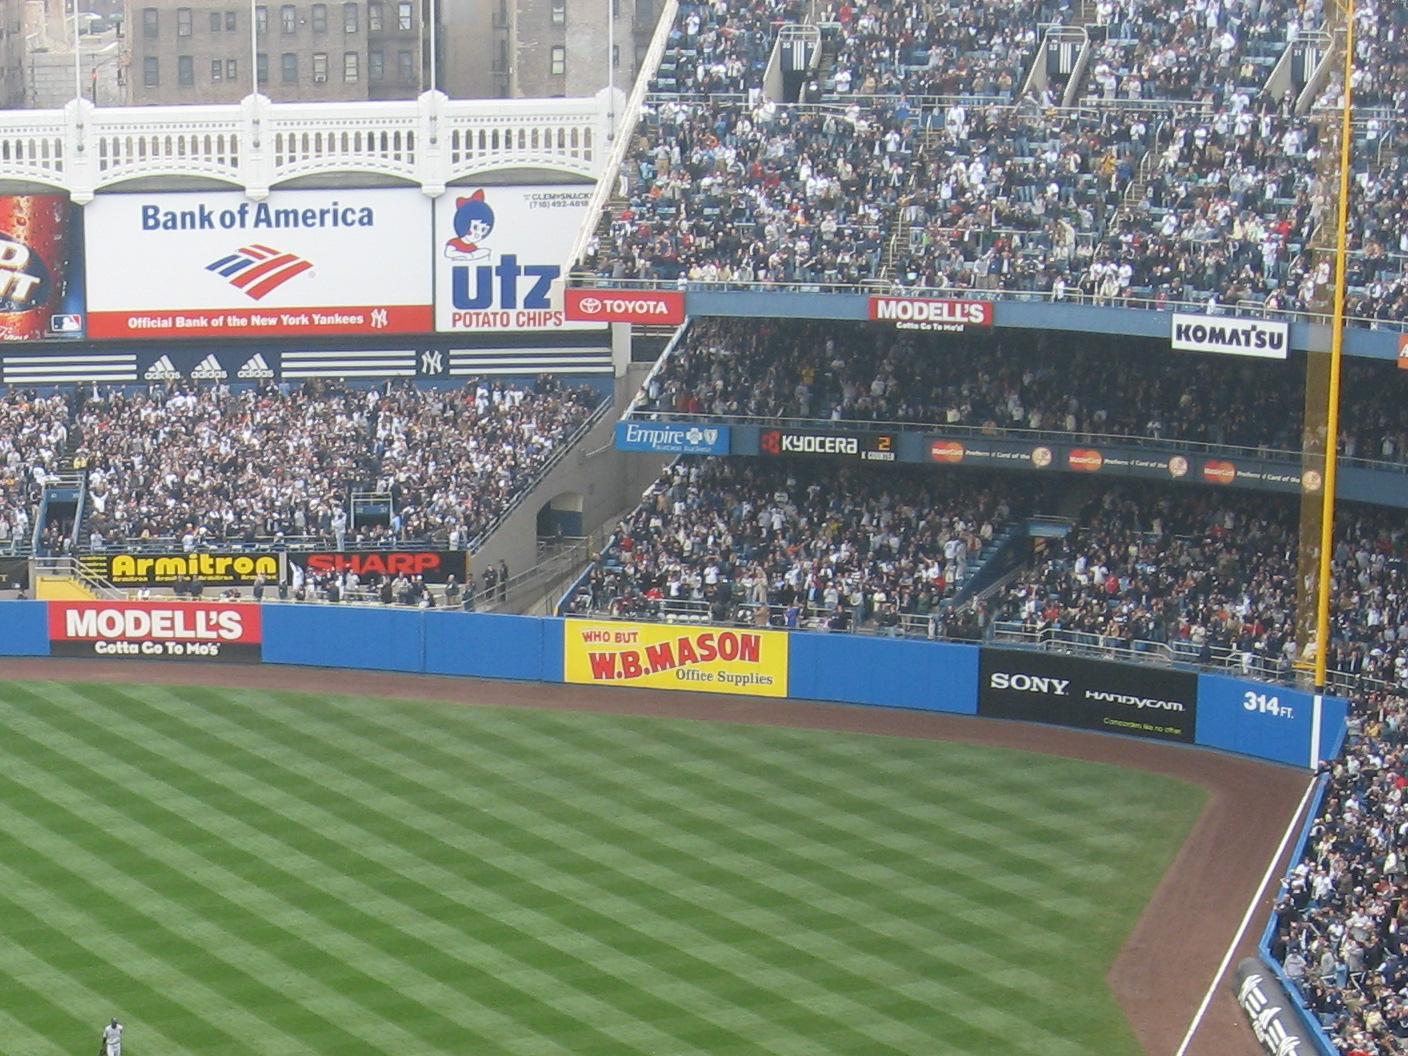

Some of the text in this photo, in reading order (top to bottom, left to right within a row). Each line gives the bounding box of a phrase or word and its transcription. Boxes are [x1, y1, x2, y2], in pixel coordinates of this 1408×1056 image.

[142, 201, 374, 230] Bank of America
[452, 254, 561, 310] utz
[603, 301, 669, 314] TOYOTA
[877, 299, 985, 324] MODELL'S
[127, 313, 365, 329] Official Bank of the New York Yankees
[452, 310, 563, 328] POTATO CHIPS
[1175, 324, 1284, 350] KOMATSU
[190, 370, 228, 379] adidas
[237, 368, 274, 378] adidas
[626, 424, 684, 448] Empire
[782, 435, 858, 454] KYOCERA
[878, 436, 891, 451] 2
[111, 553, 277, 577] Armitron
[307, 552, 441, 575] SHARP
[65, 608, 243, 640] MODELL'S
[94, 640, 140, 655] Gotta
[141, 640, 164, 655] Go
[165, 641, 184, 655] To
[582, 630, 639, 644] WHO BUT
[675, 668, 774, 687] Office Supplies
[990, 672, 1069, 696] SONY
[1243, 690, 1281, 716] 314
